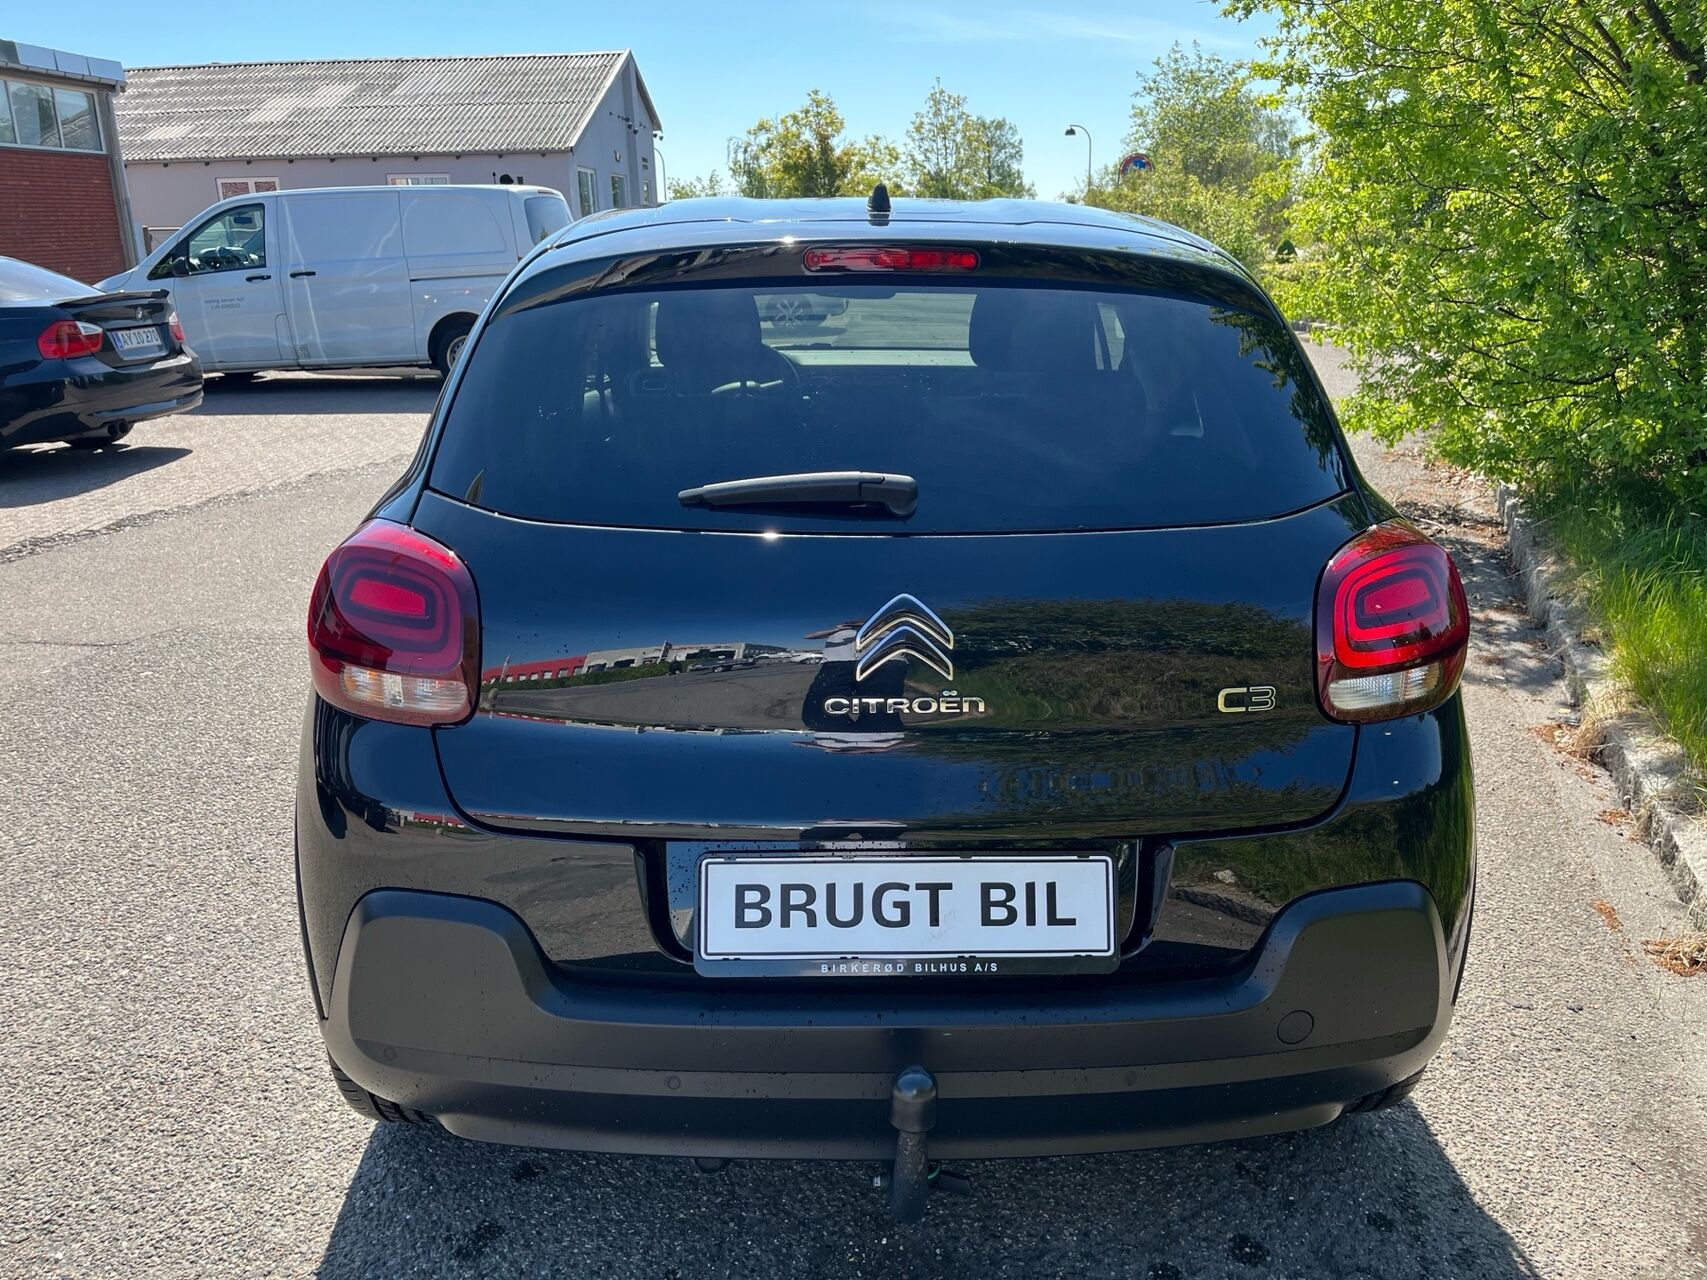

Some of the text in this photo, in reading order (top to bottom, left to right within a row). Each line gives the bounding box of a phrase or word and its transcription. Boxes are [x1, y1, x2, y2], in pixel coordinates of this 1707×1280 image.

[120, 329, 160, 346] AY 10 270
[1217, 686, 1276, 713] C3
[734, 881, 1077, 929] BRUGT BIL
[821, 962, 998, 974] BIRKERØD BILHUS A/S
